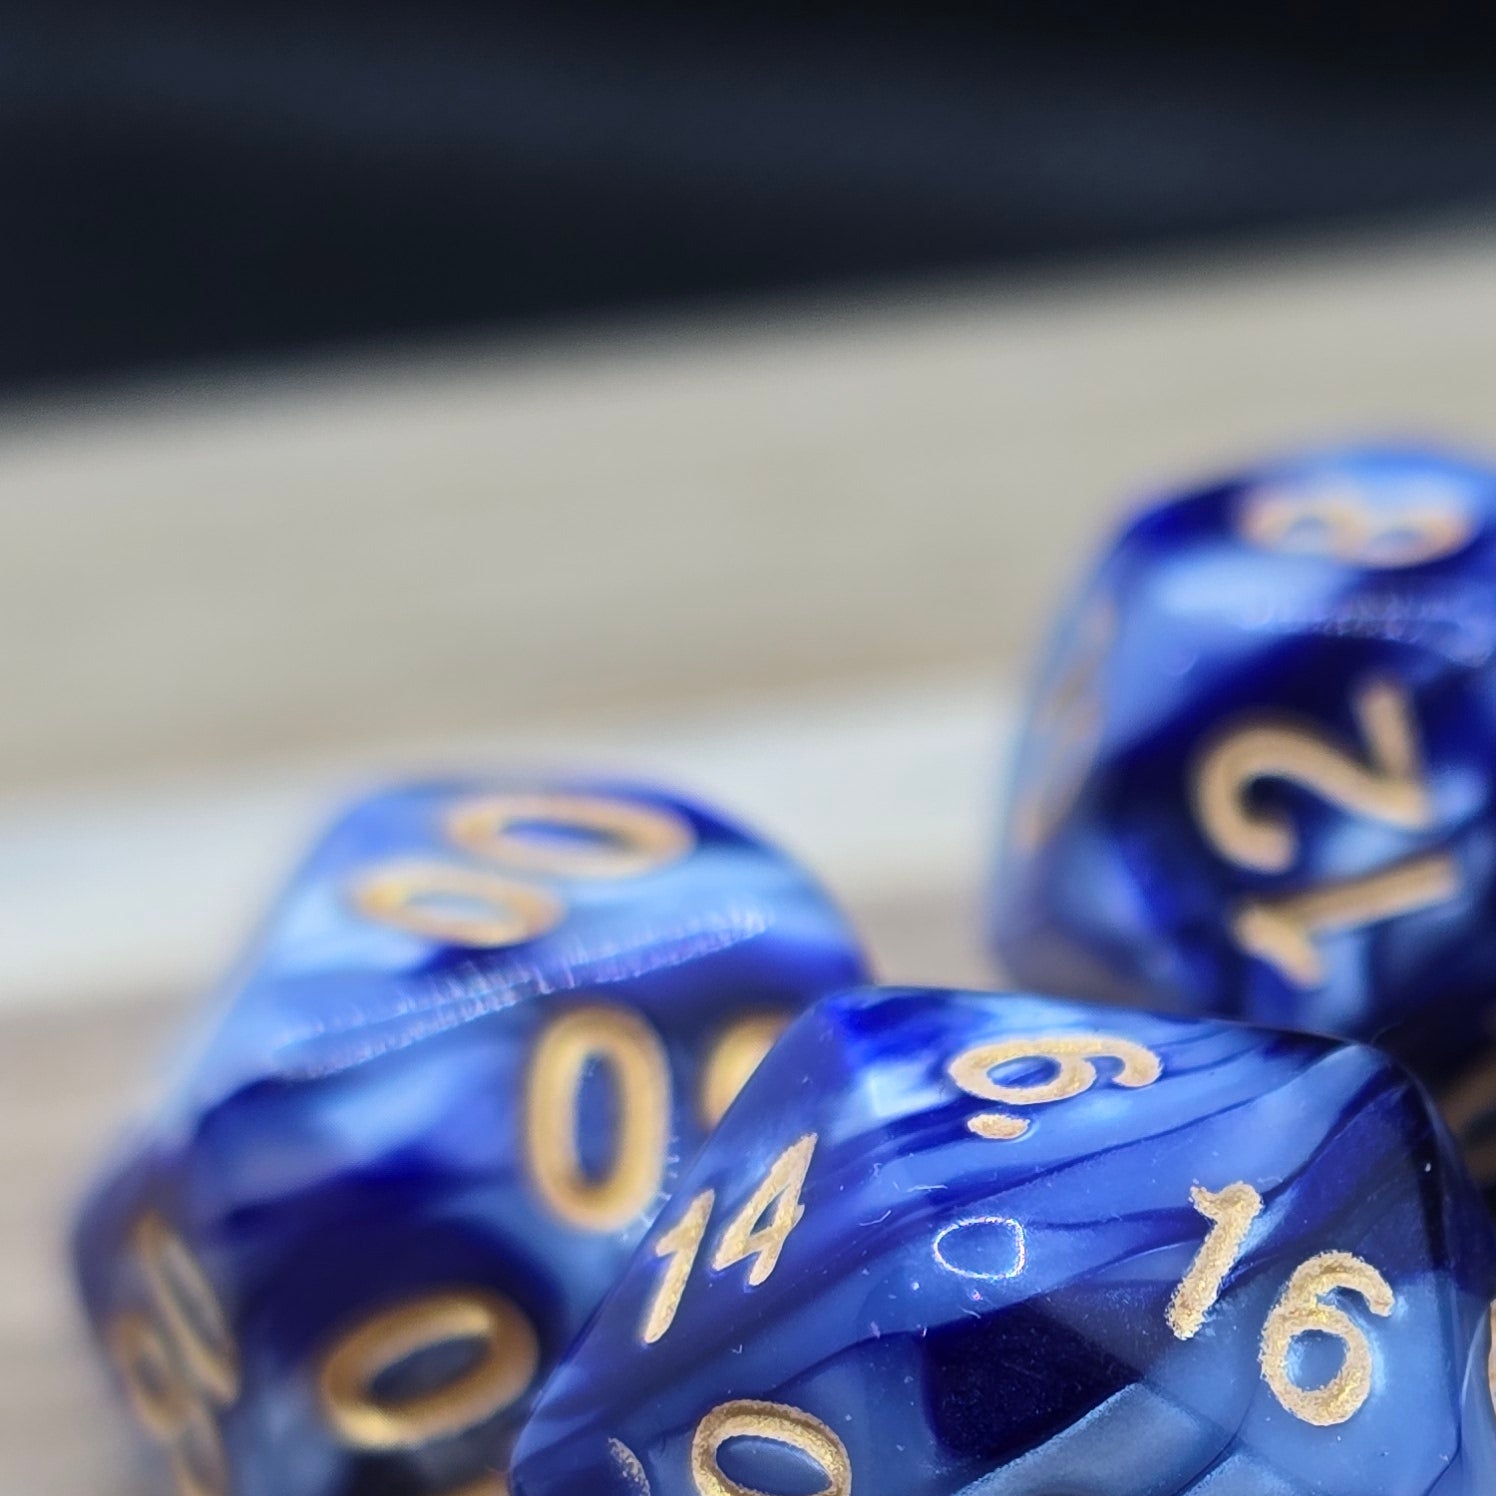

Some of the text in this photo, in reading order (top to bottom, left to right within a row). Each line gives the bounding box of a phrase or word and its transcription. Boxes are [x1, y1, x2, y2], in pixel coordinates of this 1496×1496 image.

[350, 795, 698, 946] 00
[1190, 680, 1462, 985] 12
[638, 1132, 818, 1345] 14
[1165, 1180, 1398, 1427] 16
